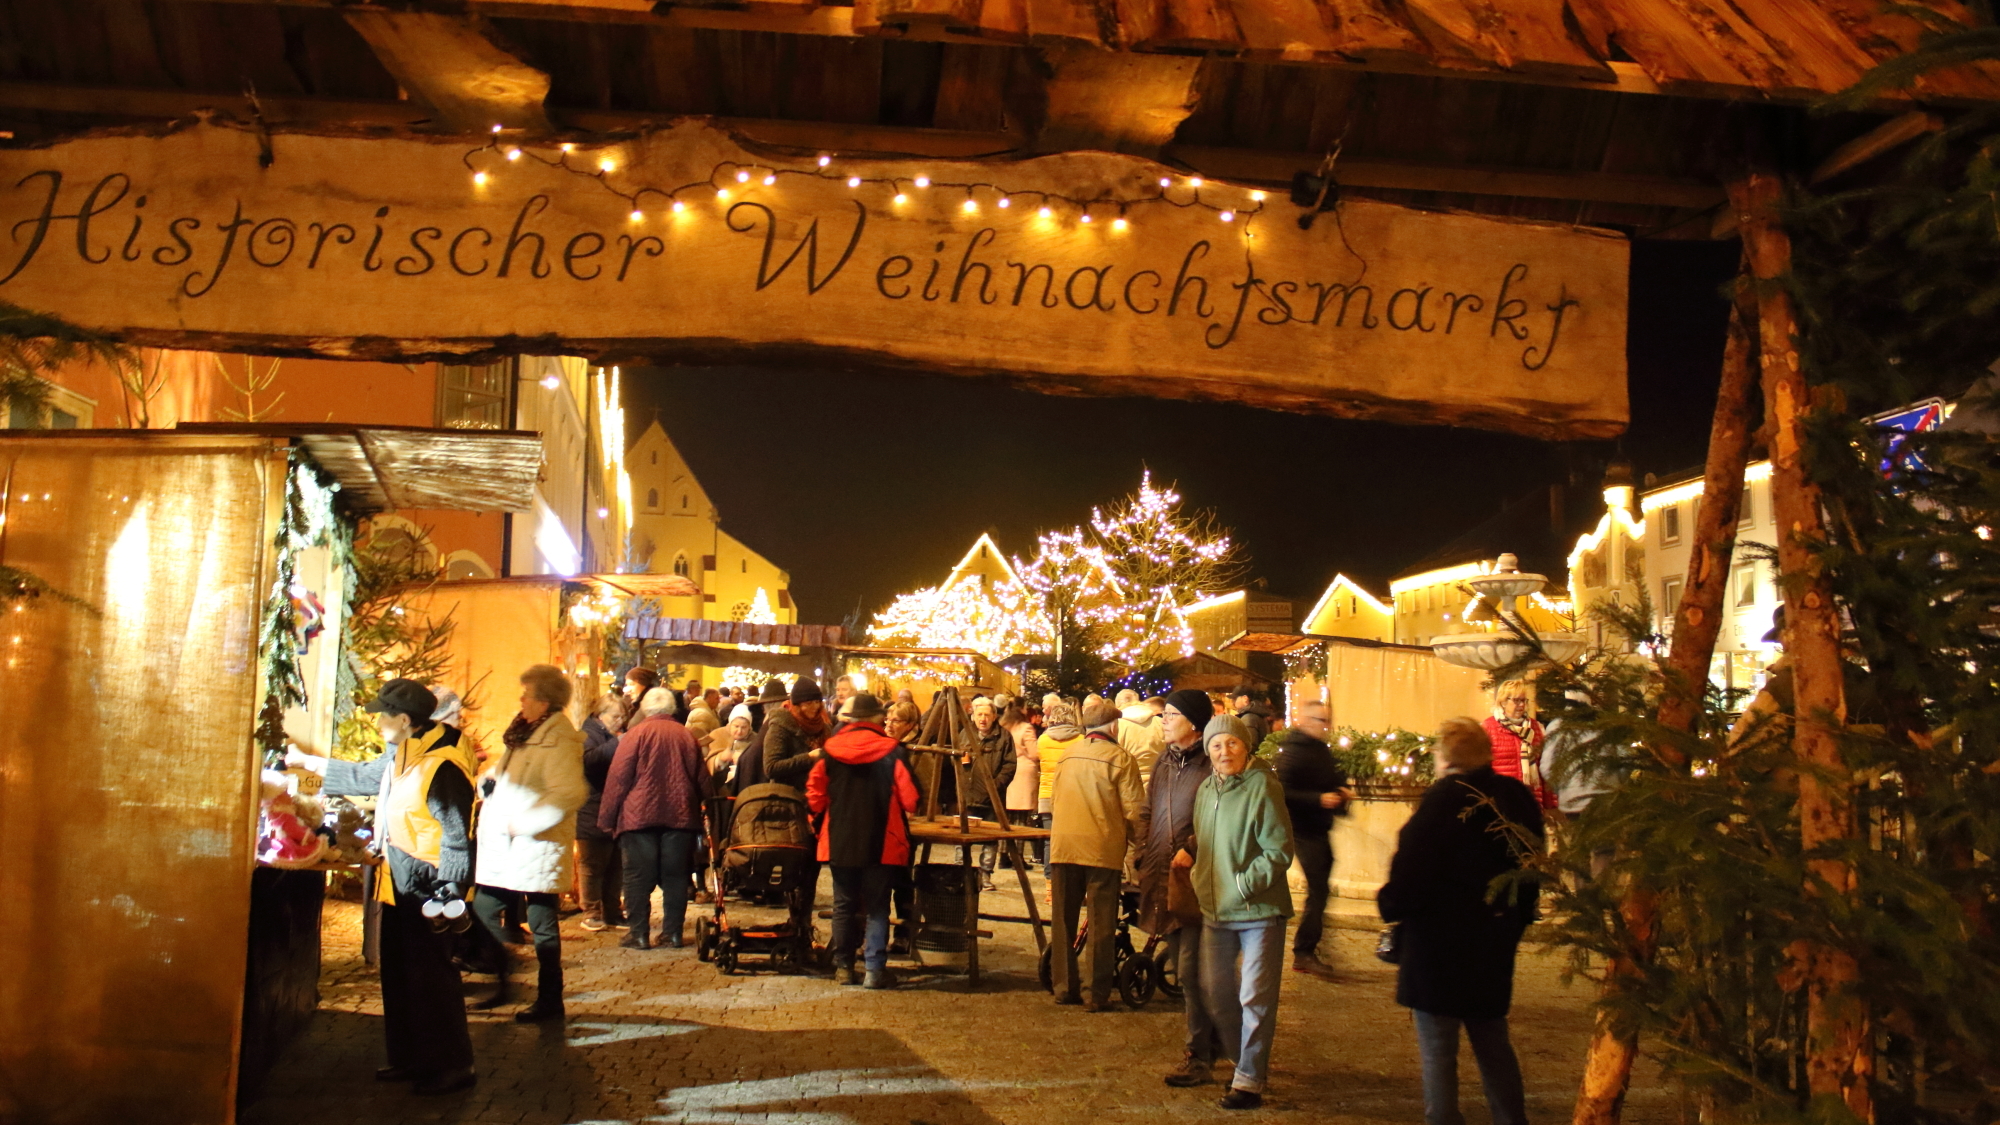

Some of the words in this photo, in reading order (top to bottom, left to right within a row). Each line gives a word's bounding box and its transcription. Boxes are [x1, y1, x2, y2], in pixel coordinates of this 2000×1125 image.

[0, 170, 664, 298] Historischer
[727, 201, 1579, 370] Weihnachtsmarkt
[1249, 604, 1290, 613] SYSTEMA
